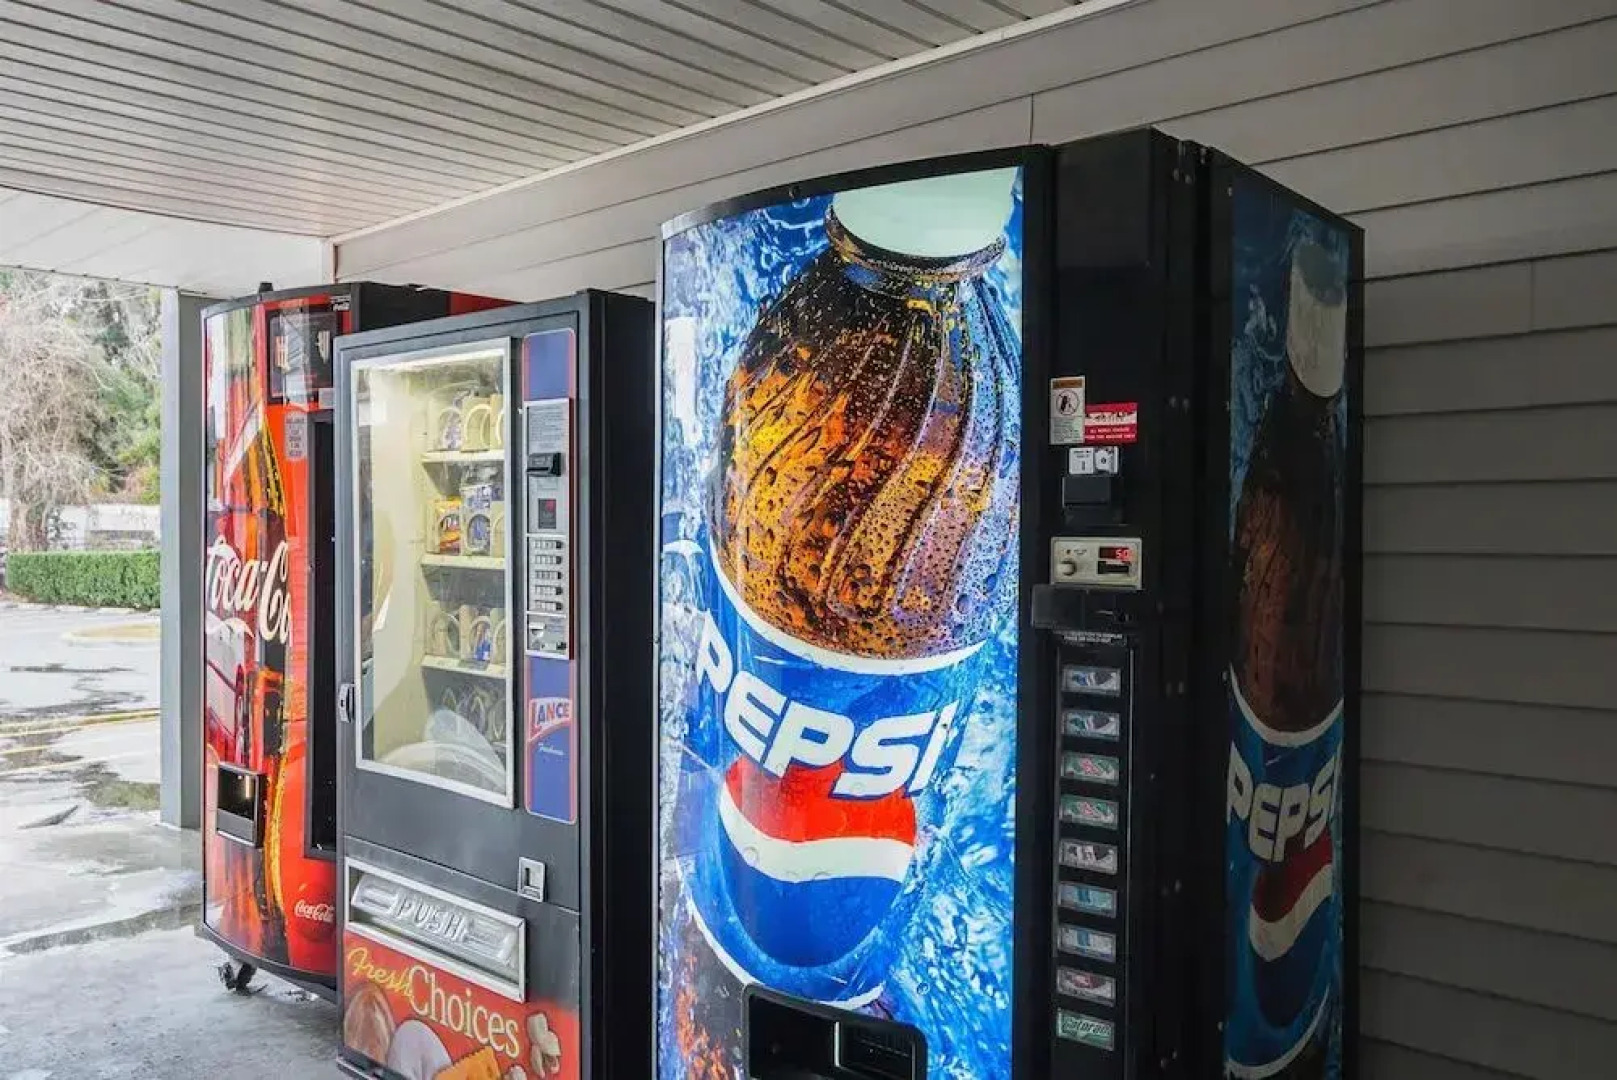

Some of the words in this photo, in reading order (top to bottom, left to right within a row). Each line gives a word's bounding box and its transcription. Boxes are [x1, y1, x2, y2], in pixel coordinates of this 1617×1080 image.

[531, 701, 570, 738] LANCE
[697, 609, 958, 798] PEPSI
[397, 892, 466, 941] PUSH
[348, 946, 414, 998] Fresh
[409, 965, 521, 1058] Choices
